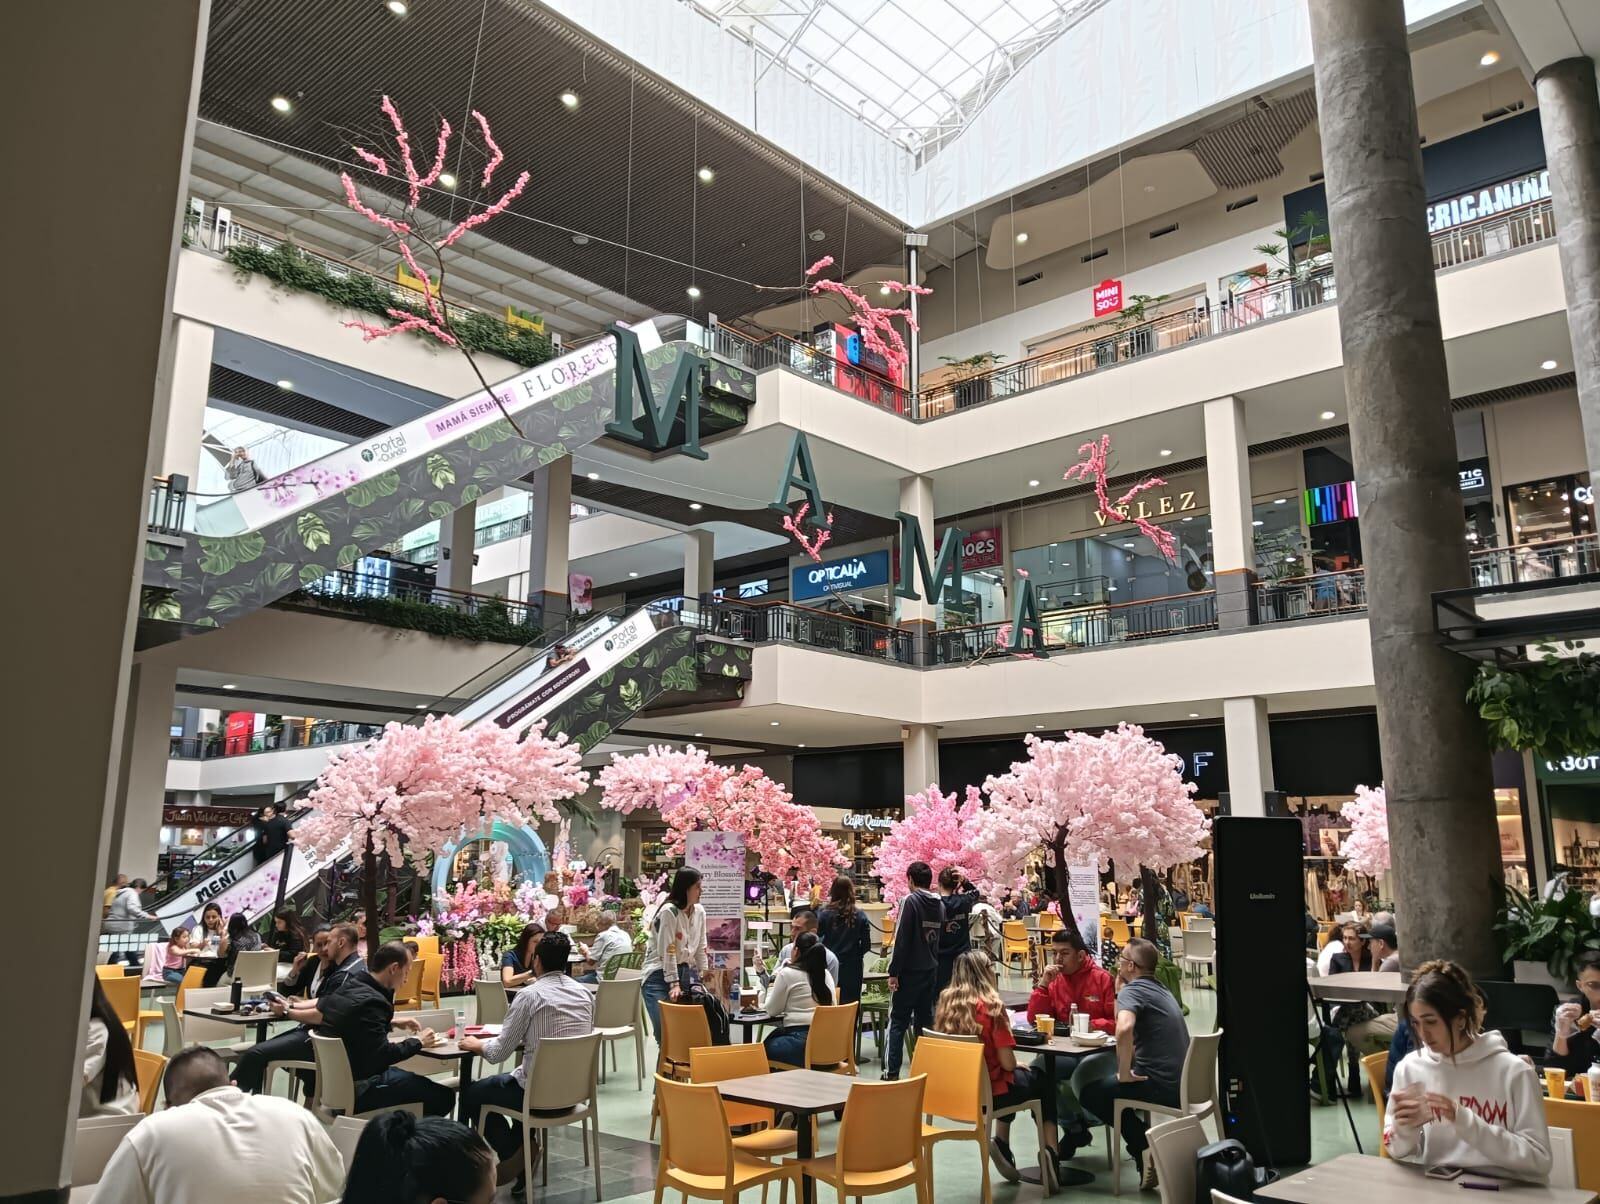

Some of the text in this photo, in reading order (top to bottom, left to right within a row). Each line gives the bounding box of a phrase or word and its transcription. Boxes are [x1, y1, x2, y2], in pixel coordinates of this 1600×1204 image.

[1096, 286, 1119, 300] MINI
[470, 394, 512, 418] SIEMPRE
[372, 432, 407, 457] Portal
[611, 620, 637, 646] Portal
[541, 687, 553, 698] CON
[164, 810, 193, 823] Juan
[843, 813, 865, 830] Café
